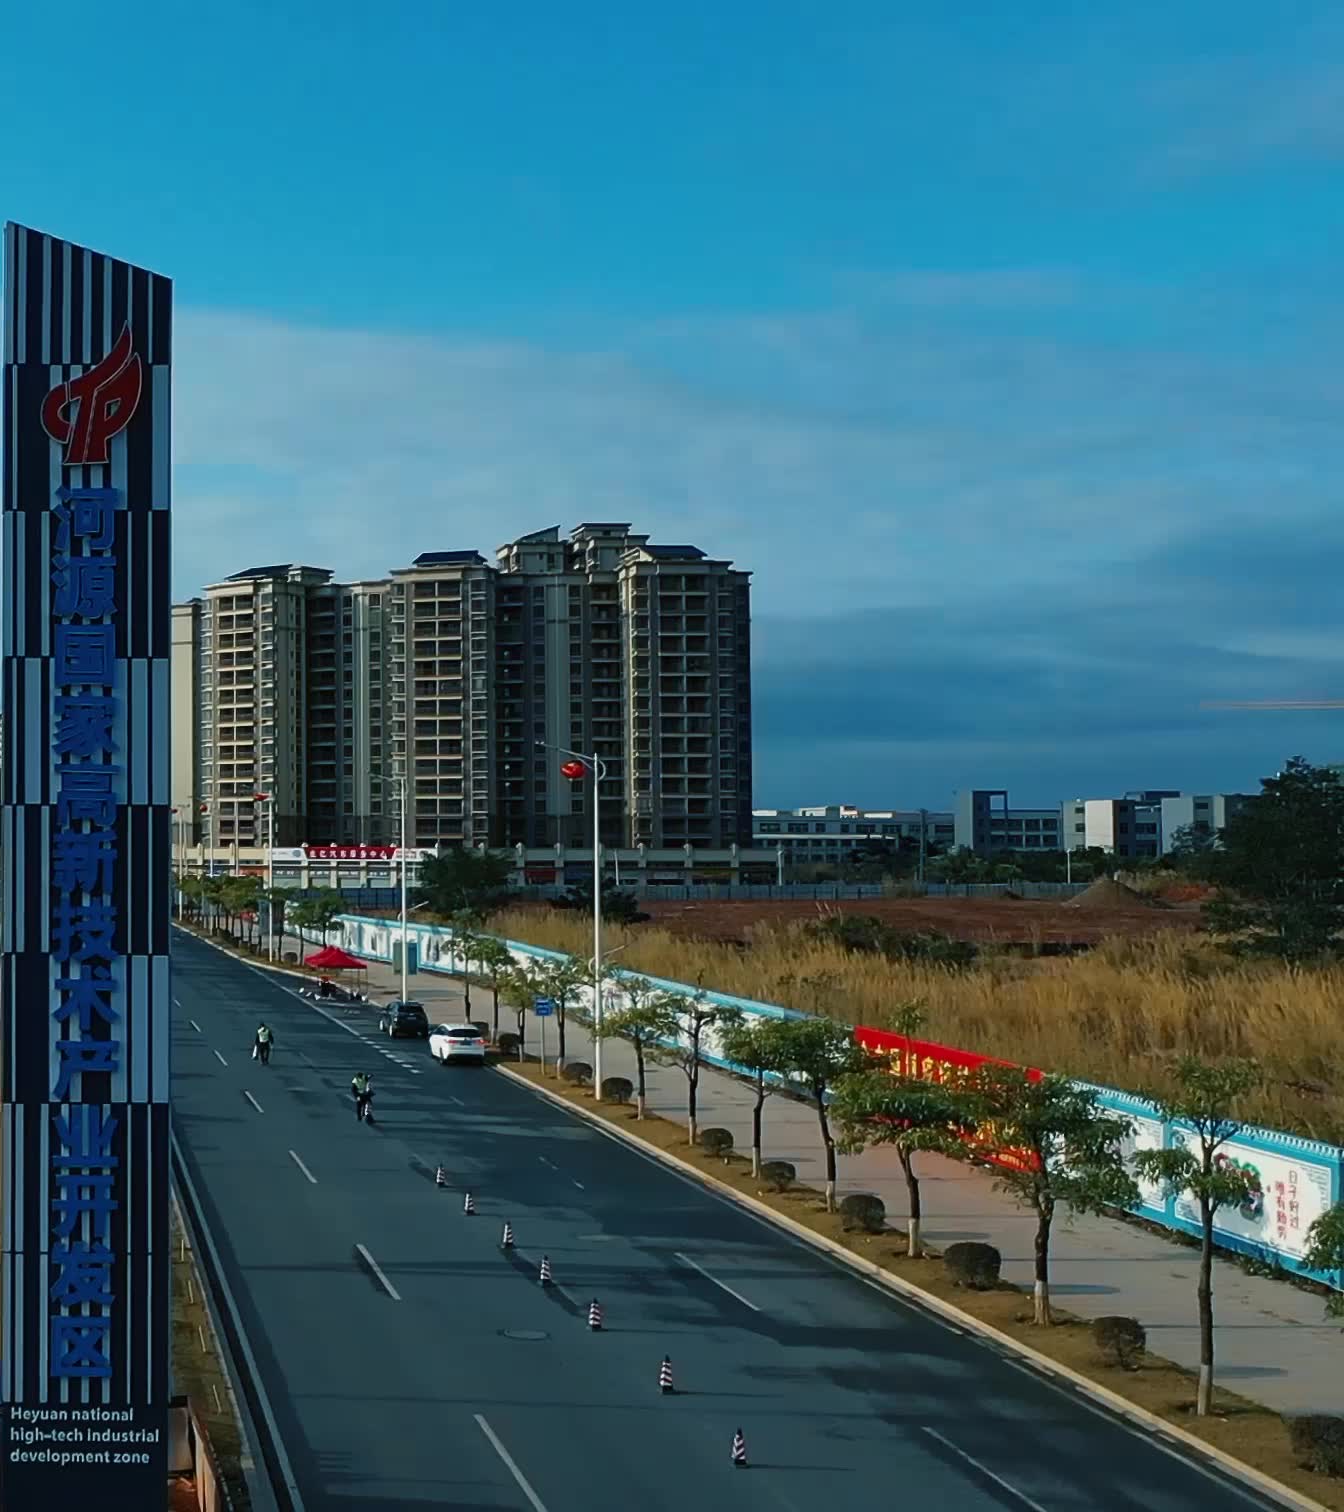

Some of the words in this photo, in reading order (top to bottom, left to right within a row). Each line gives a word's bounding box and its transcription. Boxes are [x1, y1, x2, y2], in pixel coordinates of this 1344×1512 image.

[50, 485, 120, 1377] 河源国家高新技术产业开发区
[10, 1406, 67, 1423] Heyuan
[72, 1407, 134, 1421] national
[10, 1427, 83, 1444] high-tech
[87, 1428, 159, 1442] industrial
[10, 1448, 110, 1466] development
[113, 1452, 150, 1463] zone
